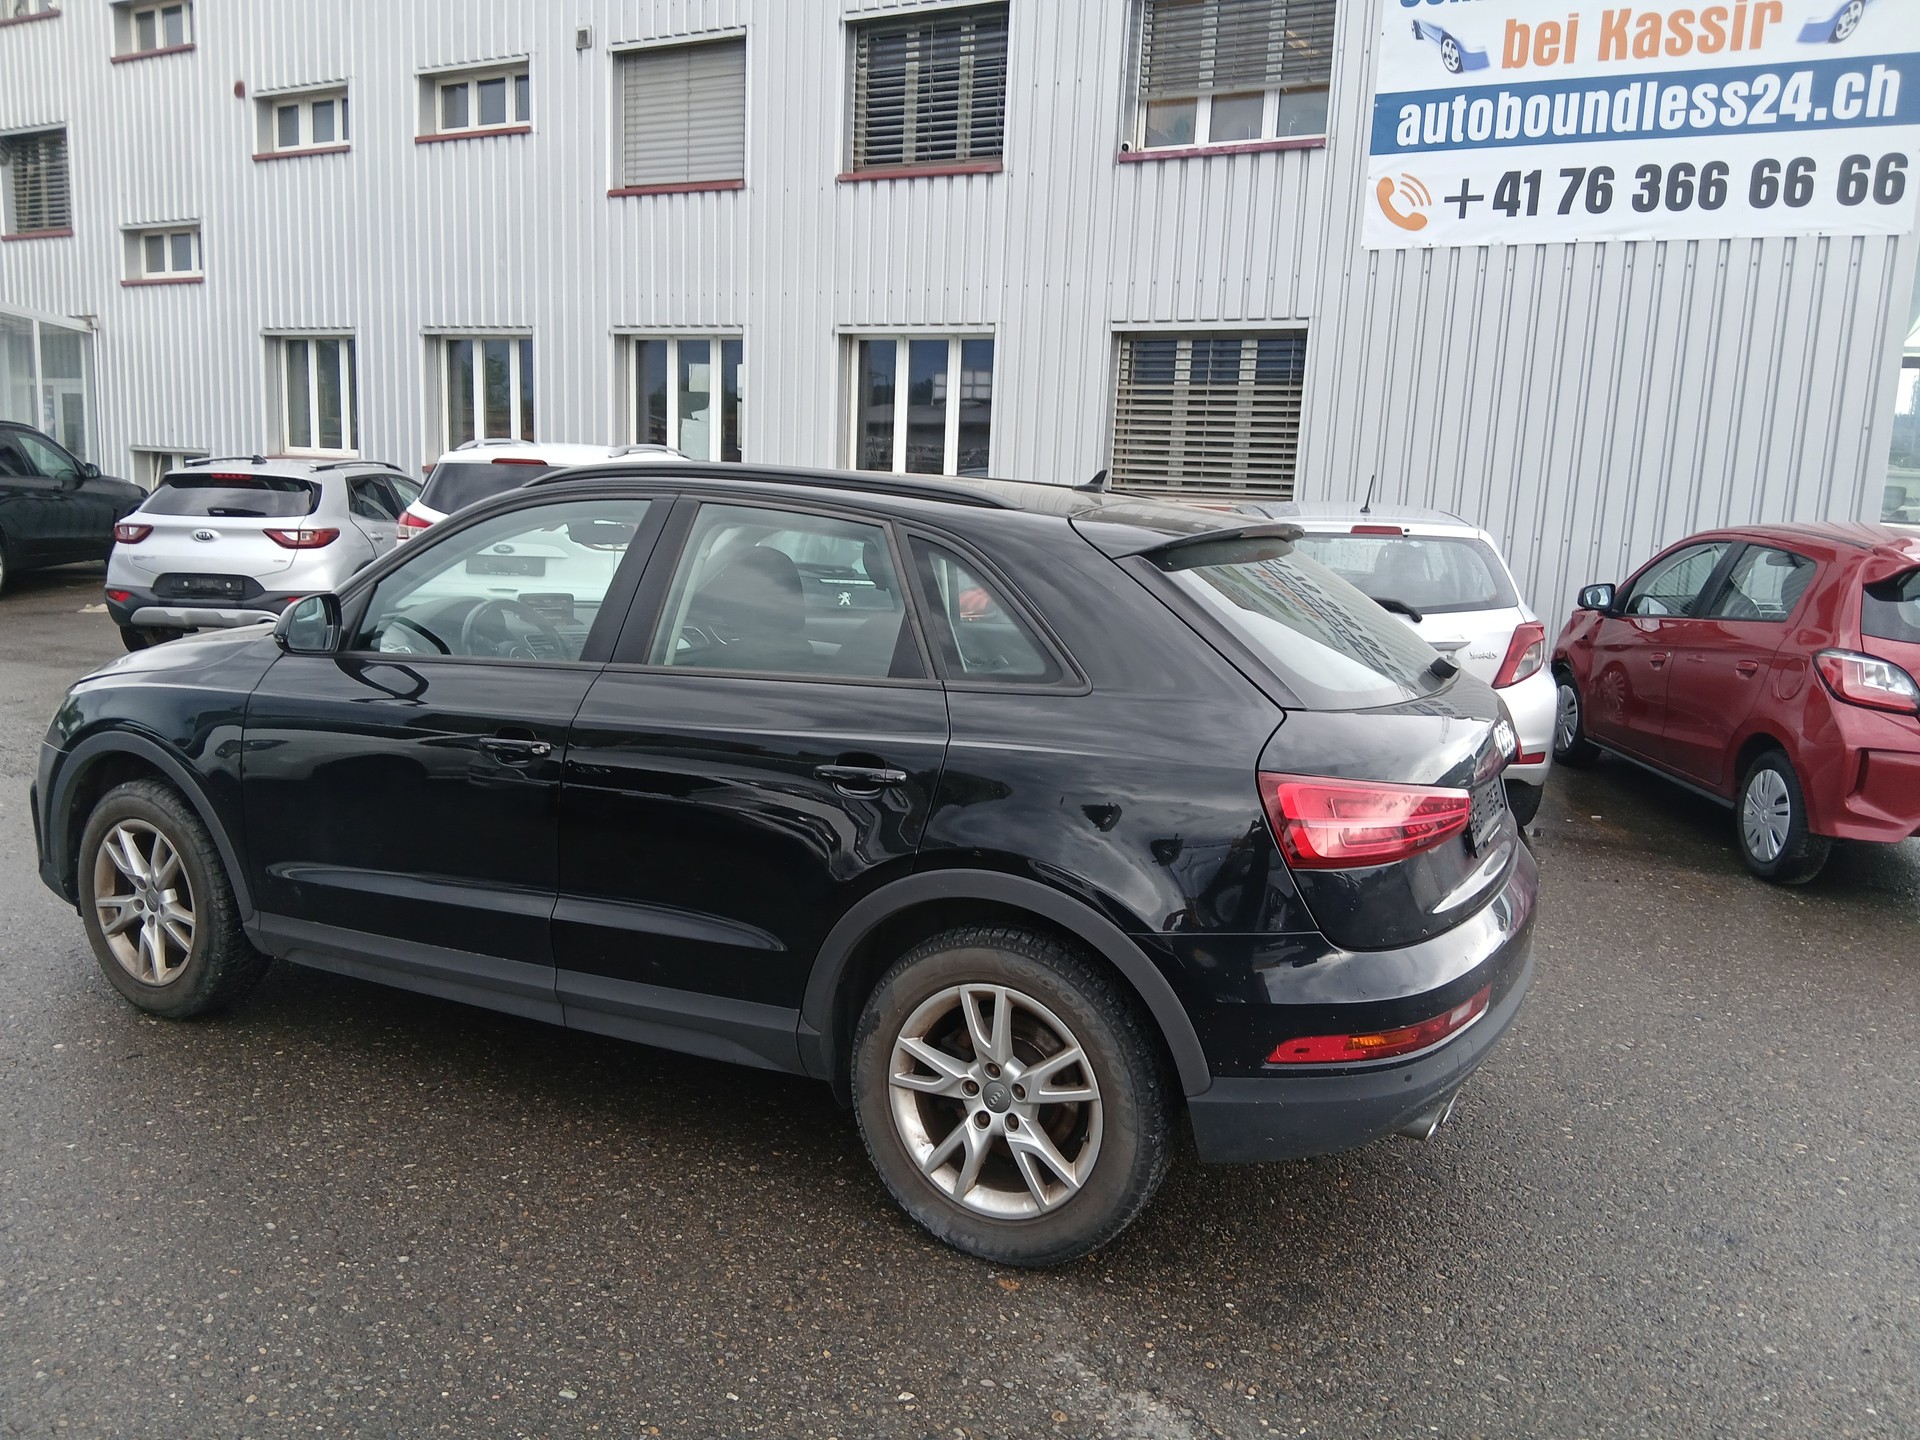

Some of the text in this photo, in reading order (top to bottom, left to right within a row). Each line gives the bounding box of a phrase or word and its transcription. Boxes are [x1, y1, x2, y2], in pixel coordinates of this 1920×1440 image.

[1502, 0, 1783, 69] bei Kassir
[1396, 63, 1902, 147] autoboundless24.ch
[1556, 165, 1615, 216] 76
[1631, 160, 1730, 213] 366
[1748, 156, 1817, 209] 66
[1836, 152, 1909, 206] 66
